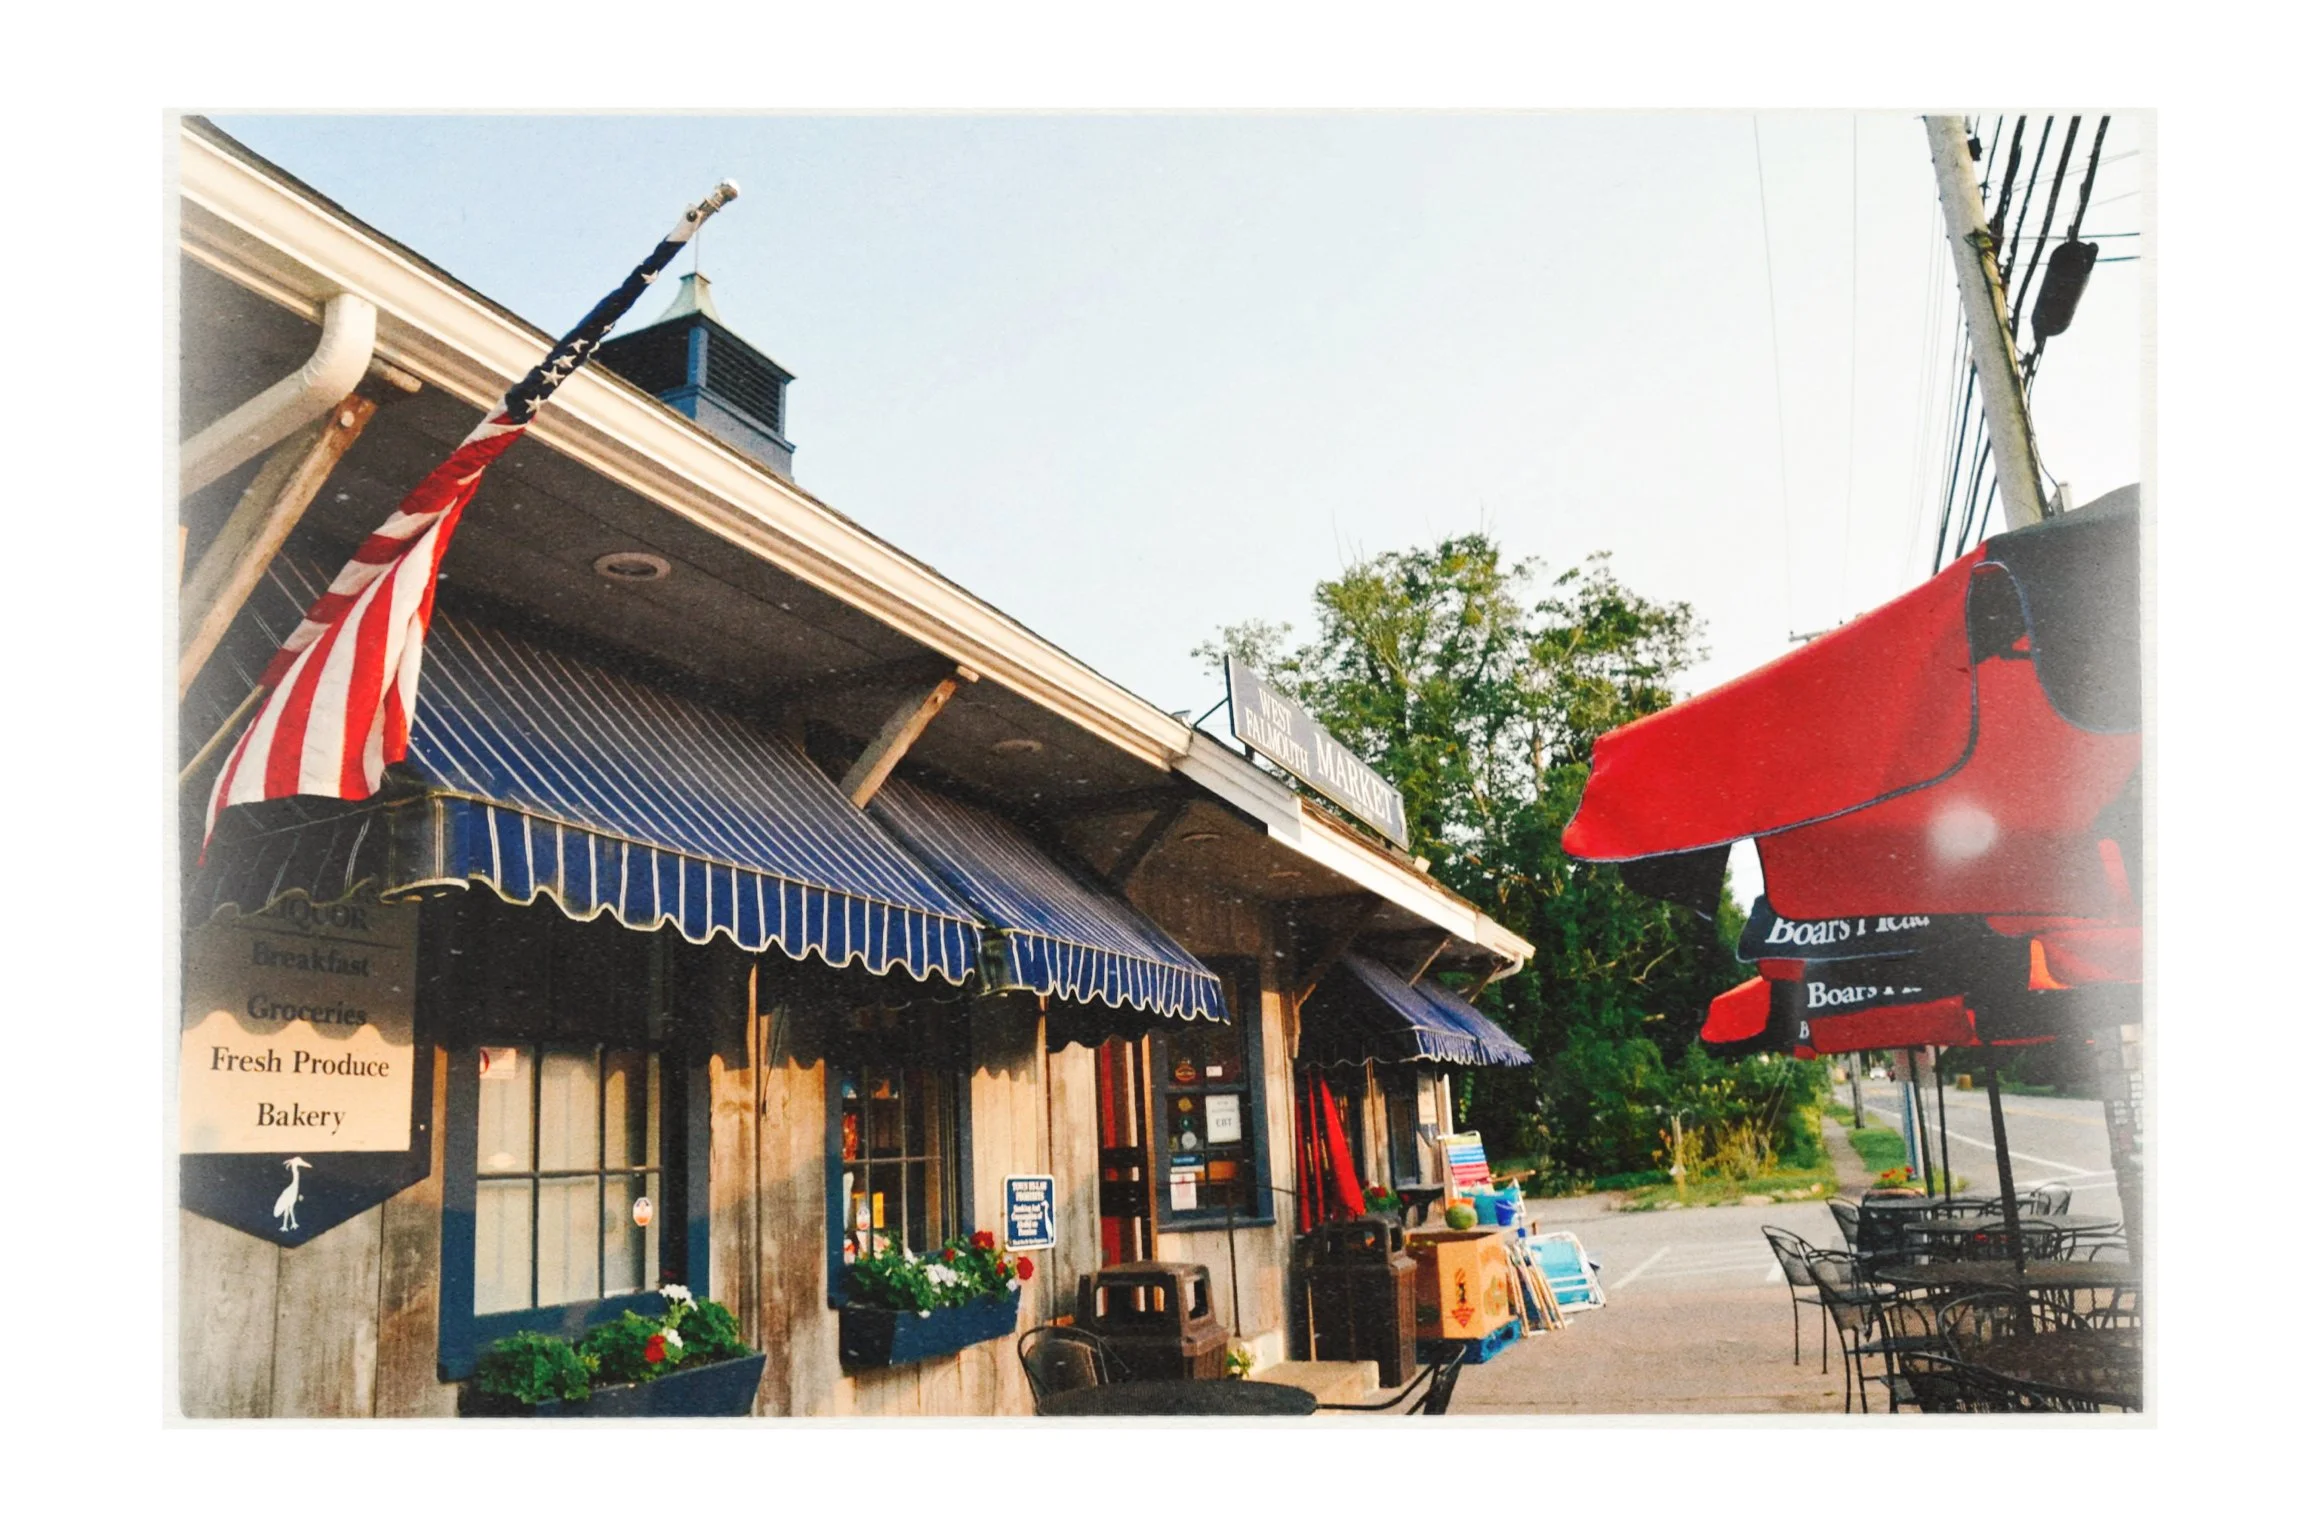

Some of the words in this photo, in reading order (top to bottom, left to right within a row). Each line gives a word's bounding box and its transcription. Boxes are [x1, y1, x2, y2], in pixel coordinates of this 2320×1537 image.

[1259, 689, 1292, 735] WEST
[1246, 708, 1310, 776] FALMOUTH
[1314, 731, 1393, 825] MARKET
[264, 899, 368, 931] IQUOR
[253, 941, 370, 977] Breakfast
[246, 995, 368, 1026] Groceries
[210, 1046, 282, 1073] Fresh
[293, 1050, 390, 1077] Produce
[256, 1102, 346, 1136] Bakery
